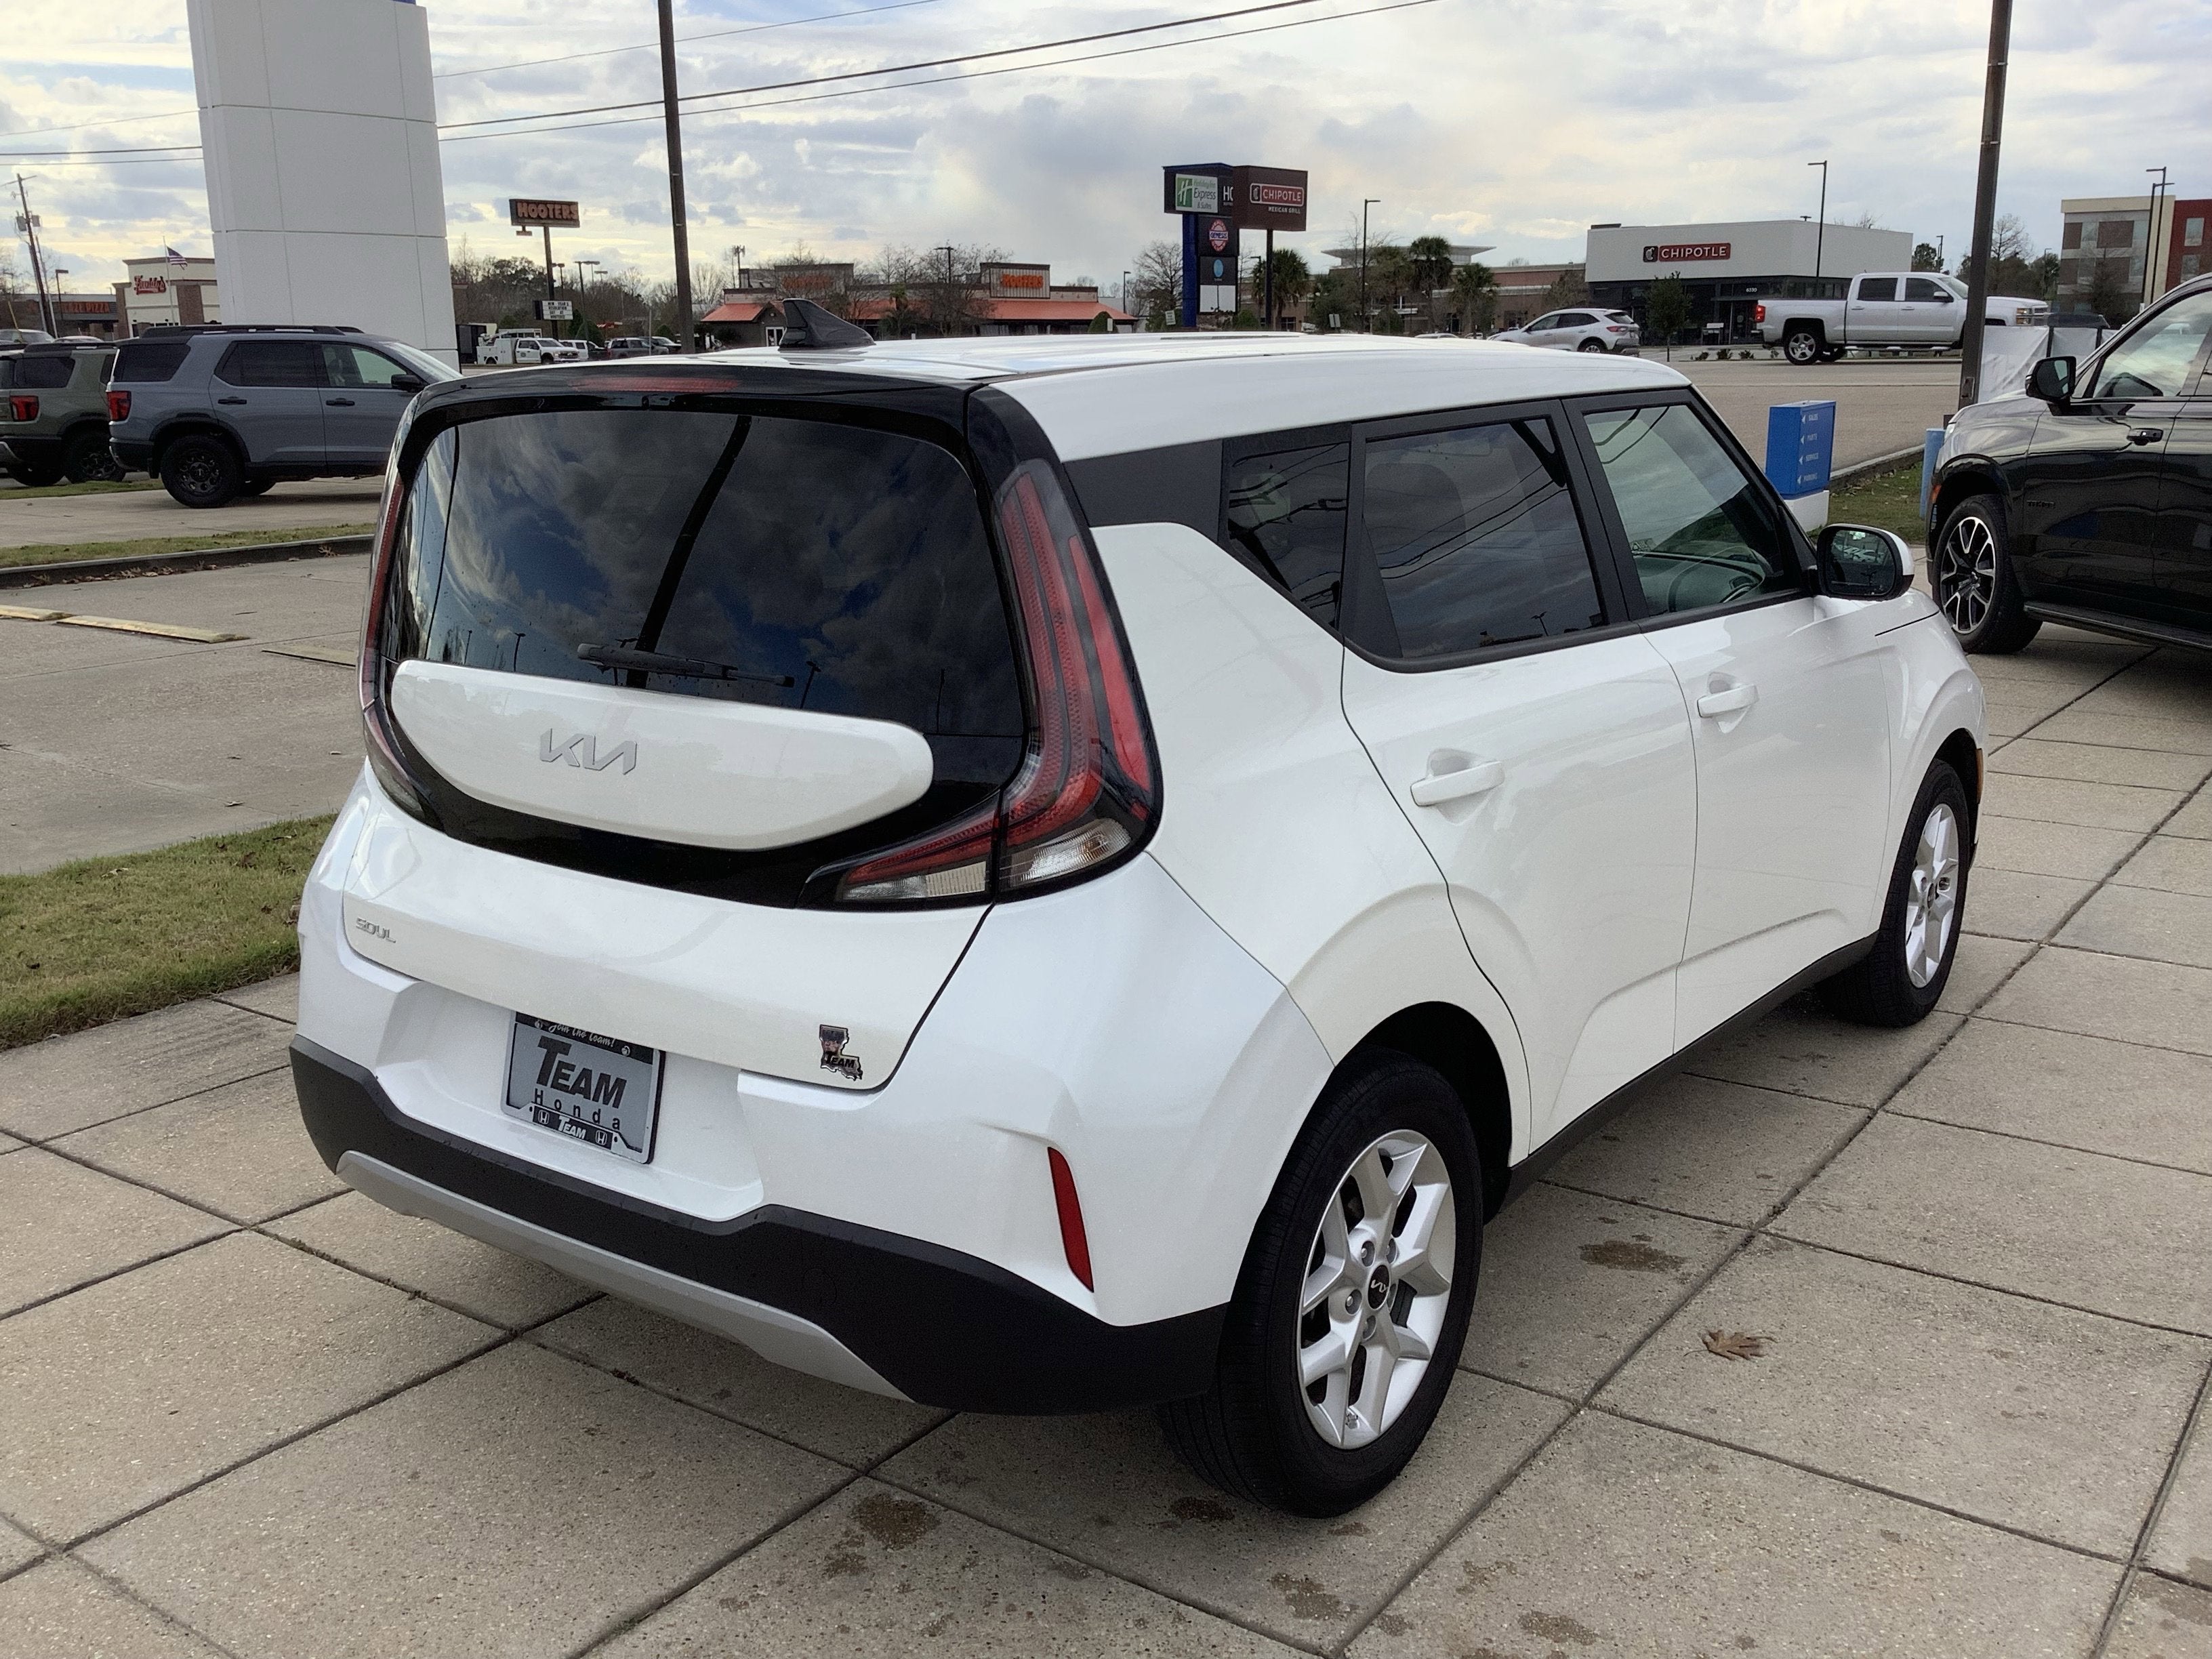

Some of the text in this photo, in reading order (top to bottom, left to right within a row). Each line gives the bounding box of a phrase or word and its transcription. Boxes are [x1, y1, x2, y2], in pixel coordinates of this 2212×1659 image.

[1193, 187, 1216, 201] Express
[1263, 189, 1302, 202] CHIPOTLE
[516, 202, 578, 220] HOOTERS
[1661, 246, 1727, 258] CHIPOTLE
[539, 728, 638, 775] KIA
[355, 916, 396, 943] SOUL
[536, 1035, 628, 1109] TEAM
[534, 1088, 620, 1130] Honda
[558, 1115, 587, 1140] TEAM
